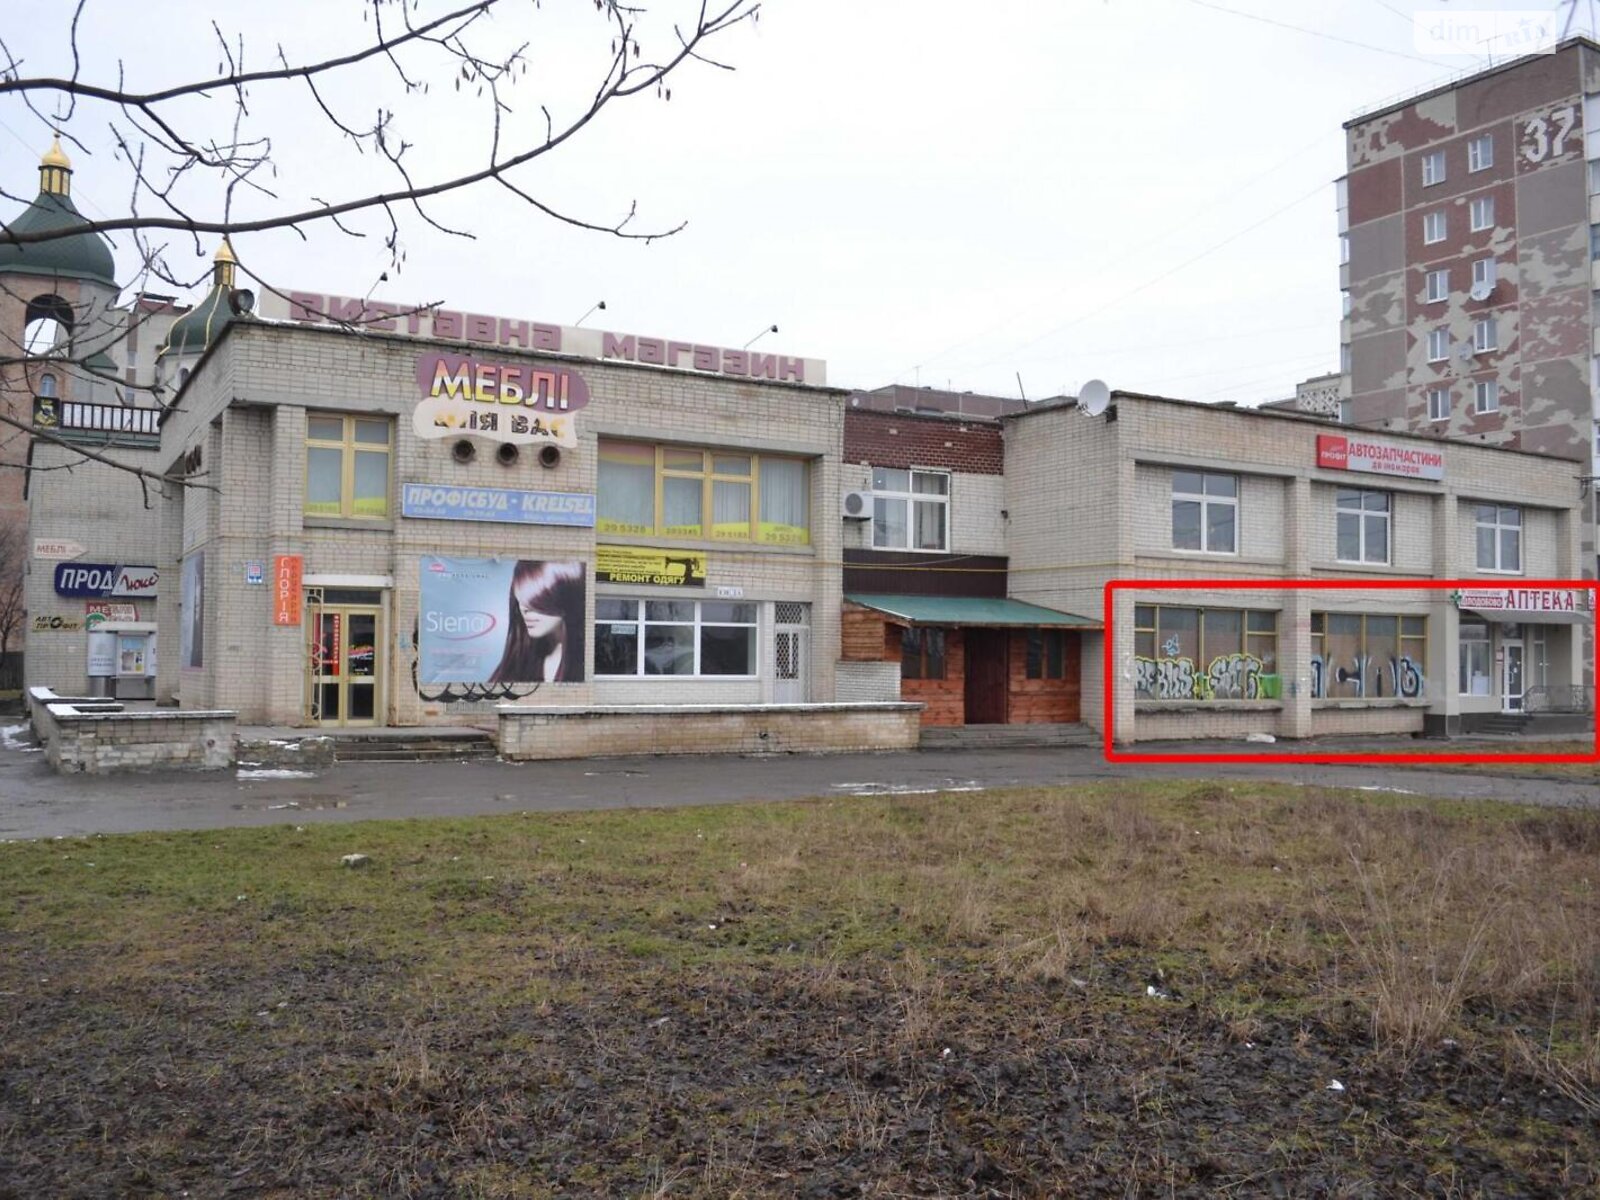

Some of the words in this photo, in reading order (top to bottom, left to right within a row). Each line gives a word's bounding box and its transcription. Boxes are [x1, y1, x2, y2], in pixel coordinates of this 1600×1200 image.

[1523, 107, 1575, 163] 37
[430, 358, 570, 409] МЕБЛІ
[1348, 442, 1442, 468] АВТОЗАПЧАСТИНИ
[409, 487, 509, 511] ПРОФІСБУД
[60, 568, 114, 590] ПРОД
[609, 573, 651, 582] РЕМОНТ
[653, 575, 686, 585] ОДЯГУ
[1505, 589, 1575, 611] АПТЕКА
